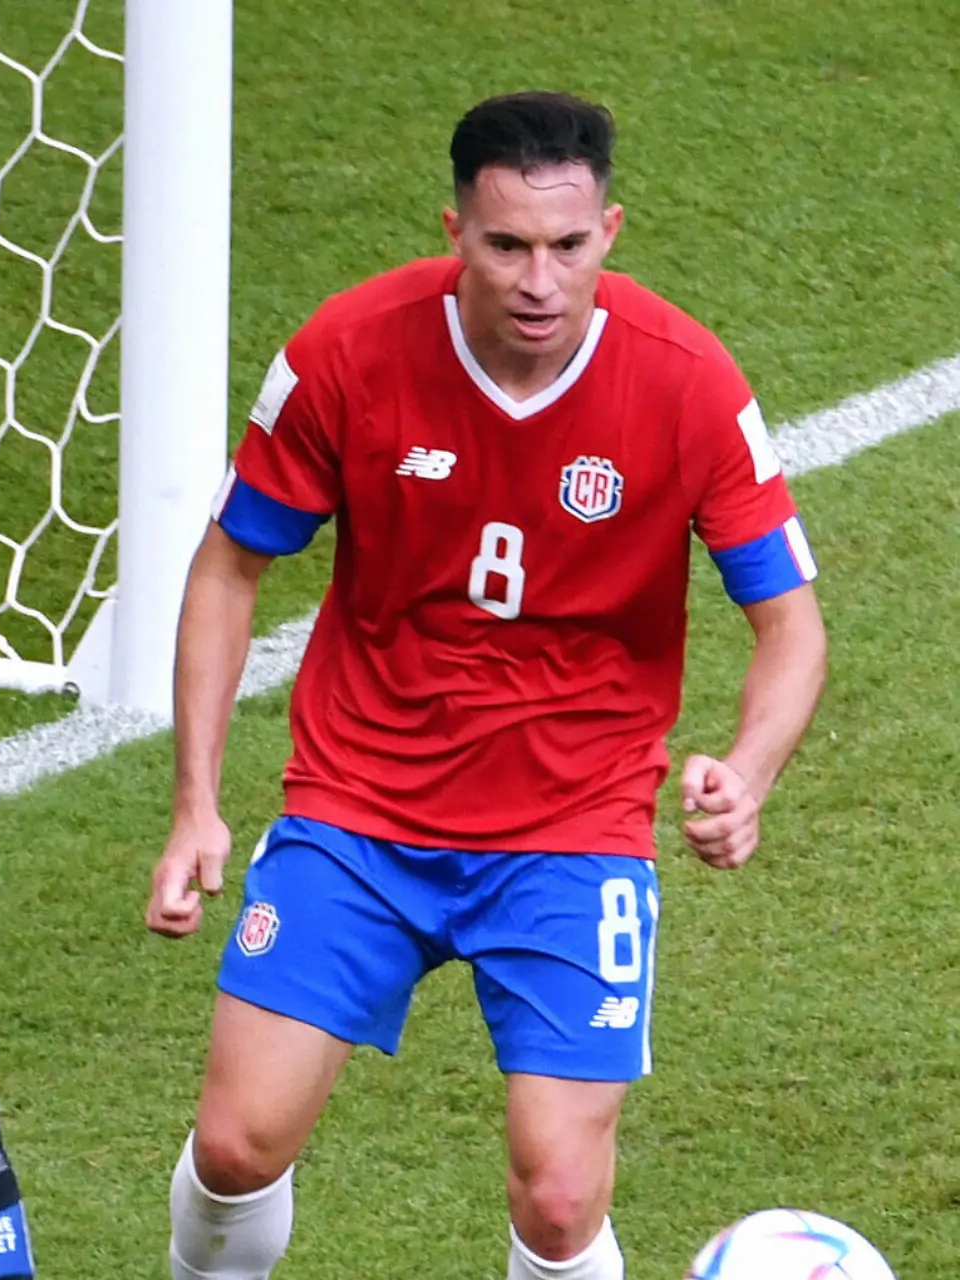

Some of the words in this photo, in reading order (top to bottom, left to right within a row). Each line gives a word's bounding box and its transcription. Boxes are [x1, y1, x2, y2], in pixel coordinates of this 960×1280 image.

[575, 469, 609, 510] CR
[468, 521, 526, 620] 8
[598, 877, 641, 983] 8
